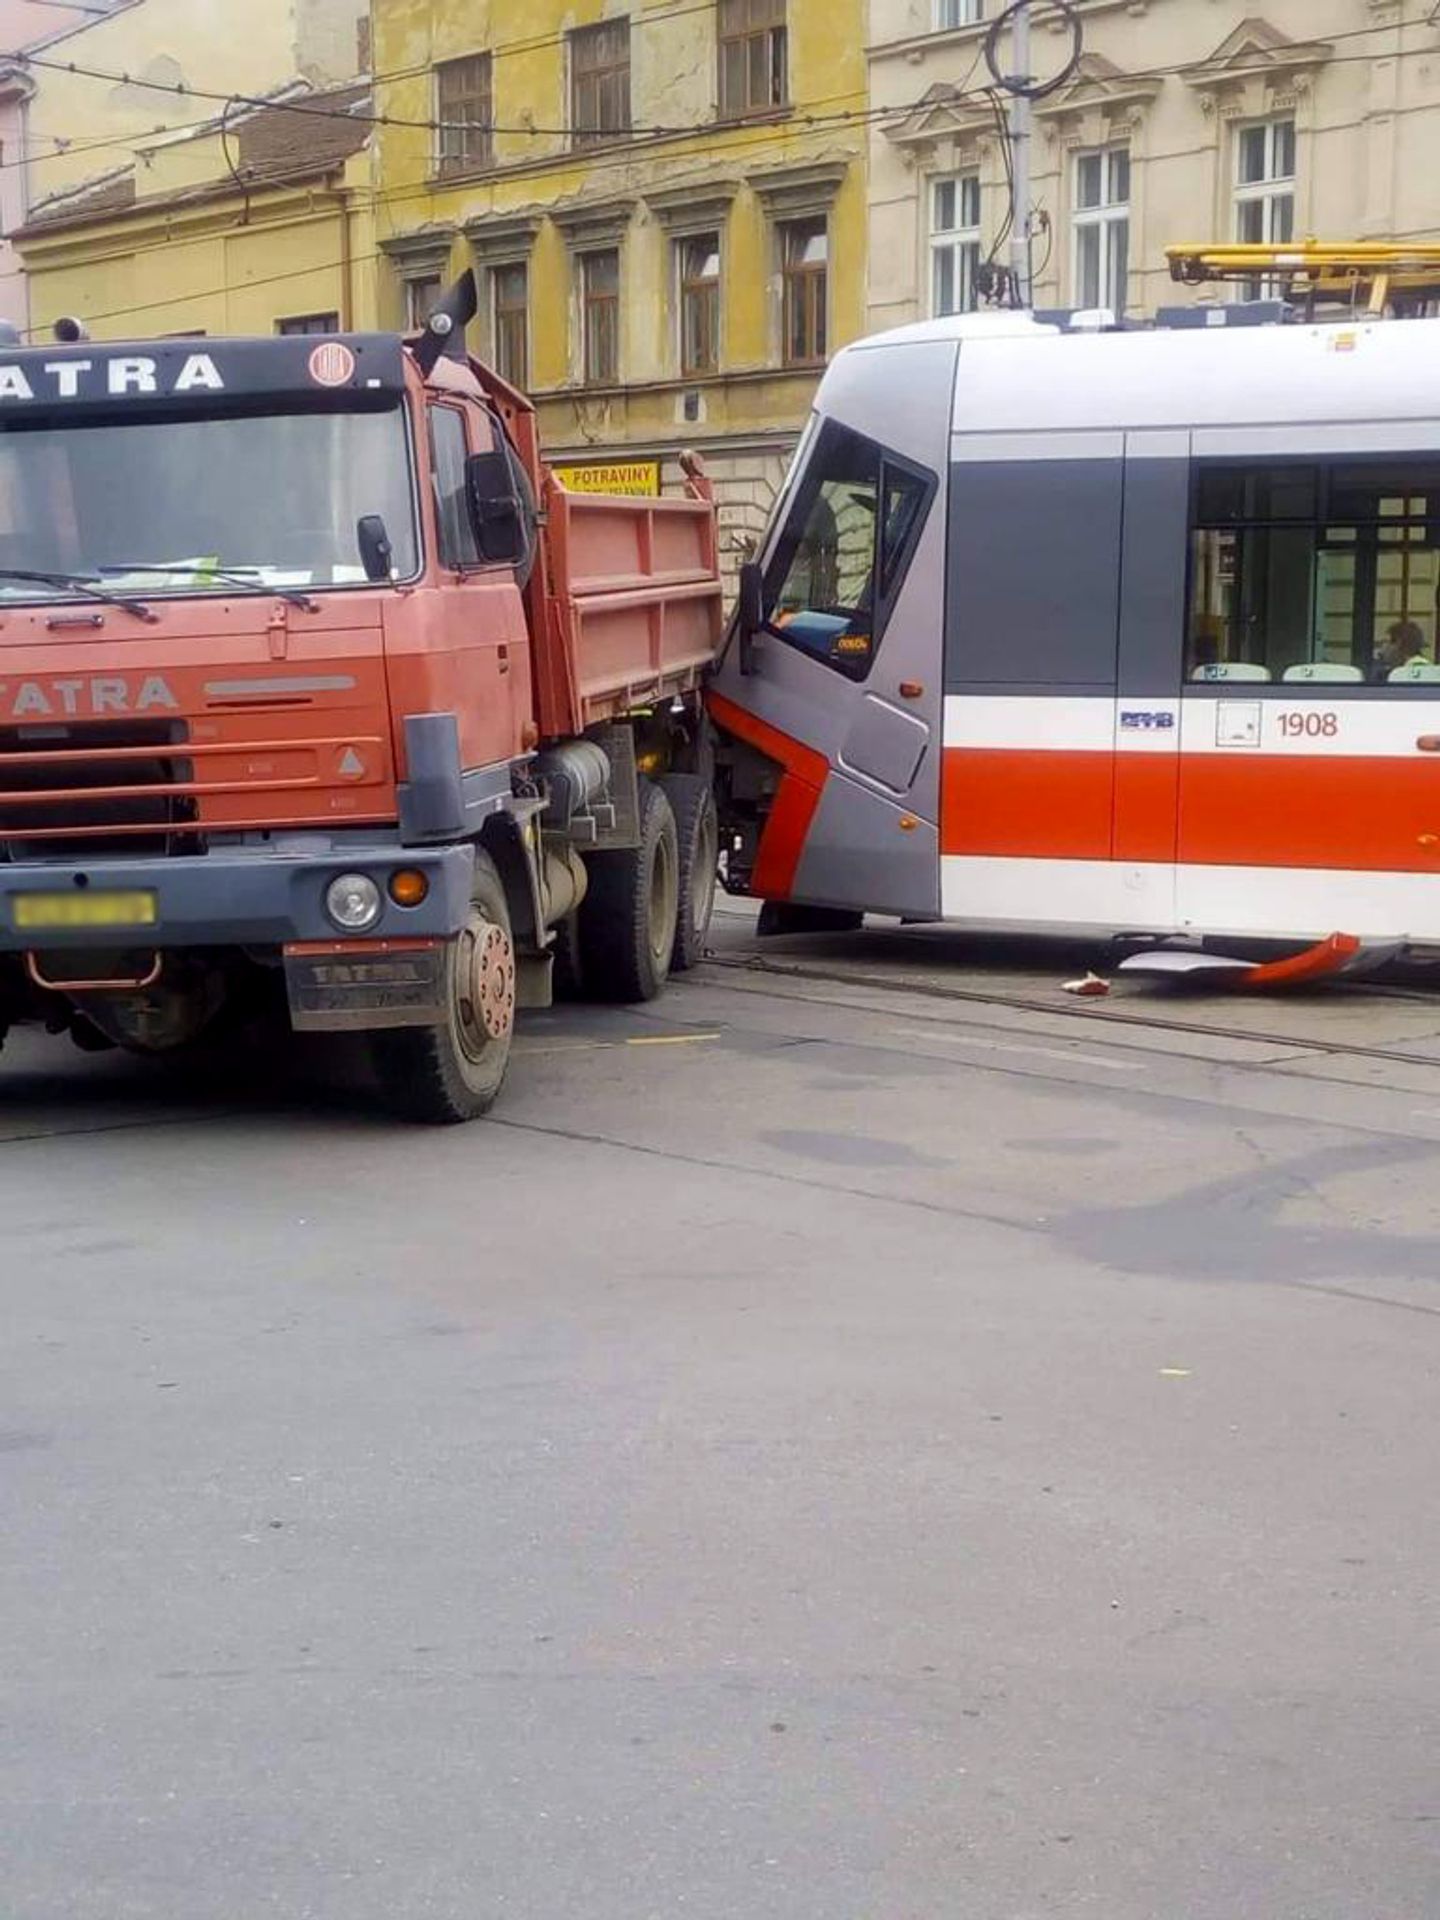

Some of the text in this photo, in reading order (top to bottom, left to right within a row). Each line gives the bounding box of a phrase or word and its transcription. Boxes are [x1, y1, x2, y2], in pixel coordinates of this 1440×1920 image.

[573, 466, 650, 484] POTRAVINY
[0, 676, 179, 716] ATRA
[1277, 712, 1338, 737] 1908
